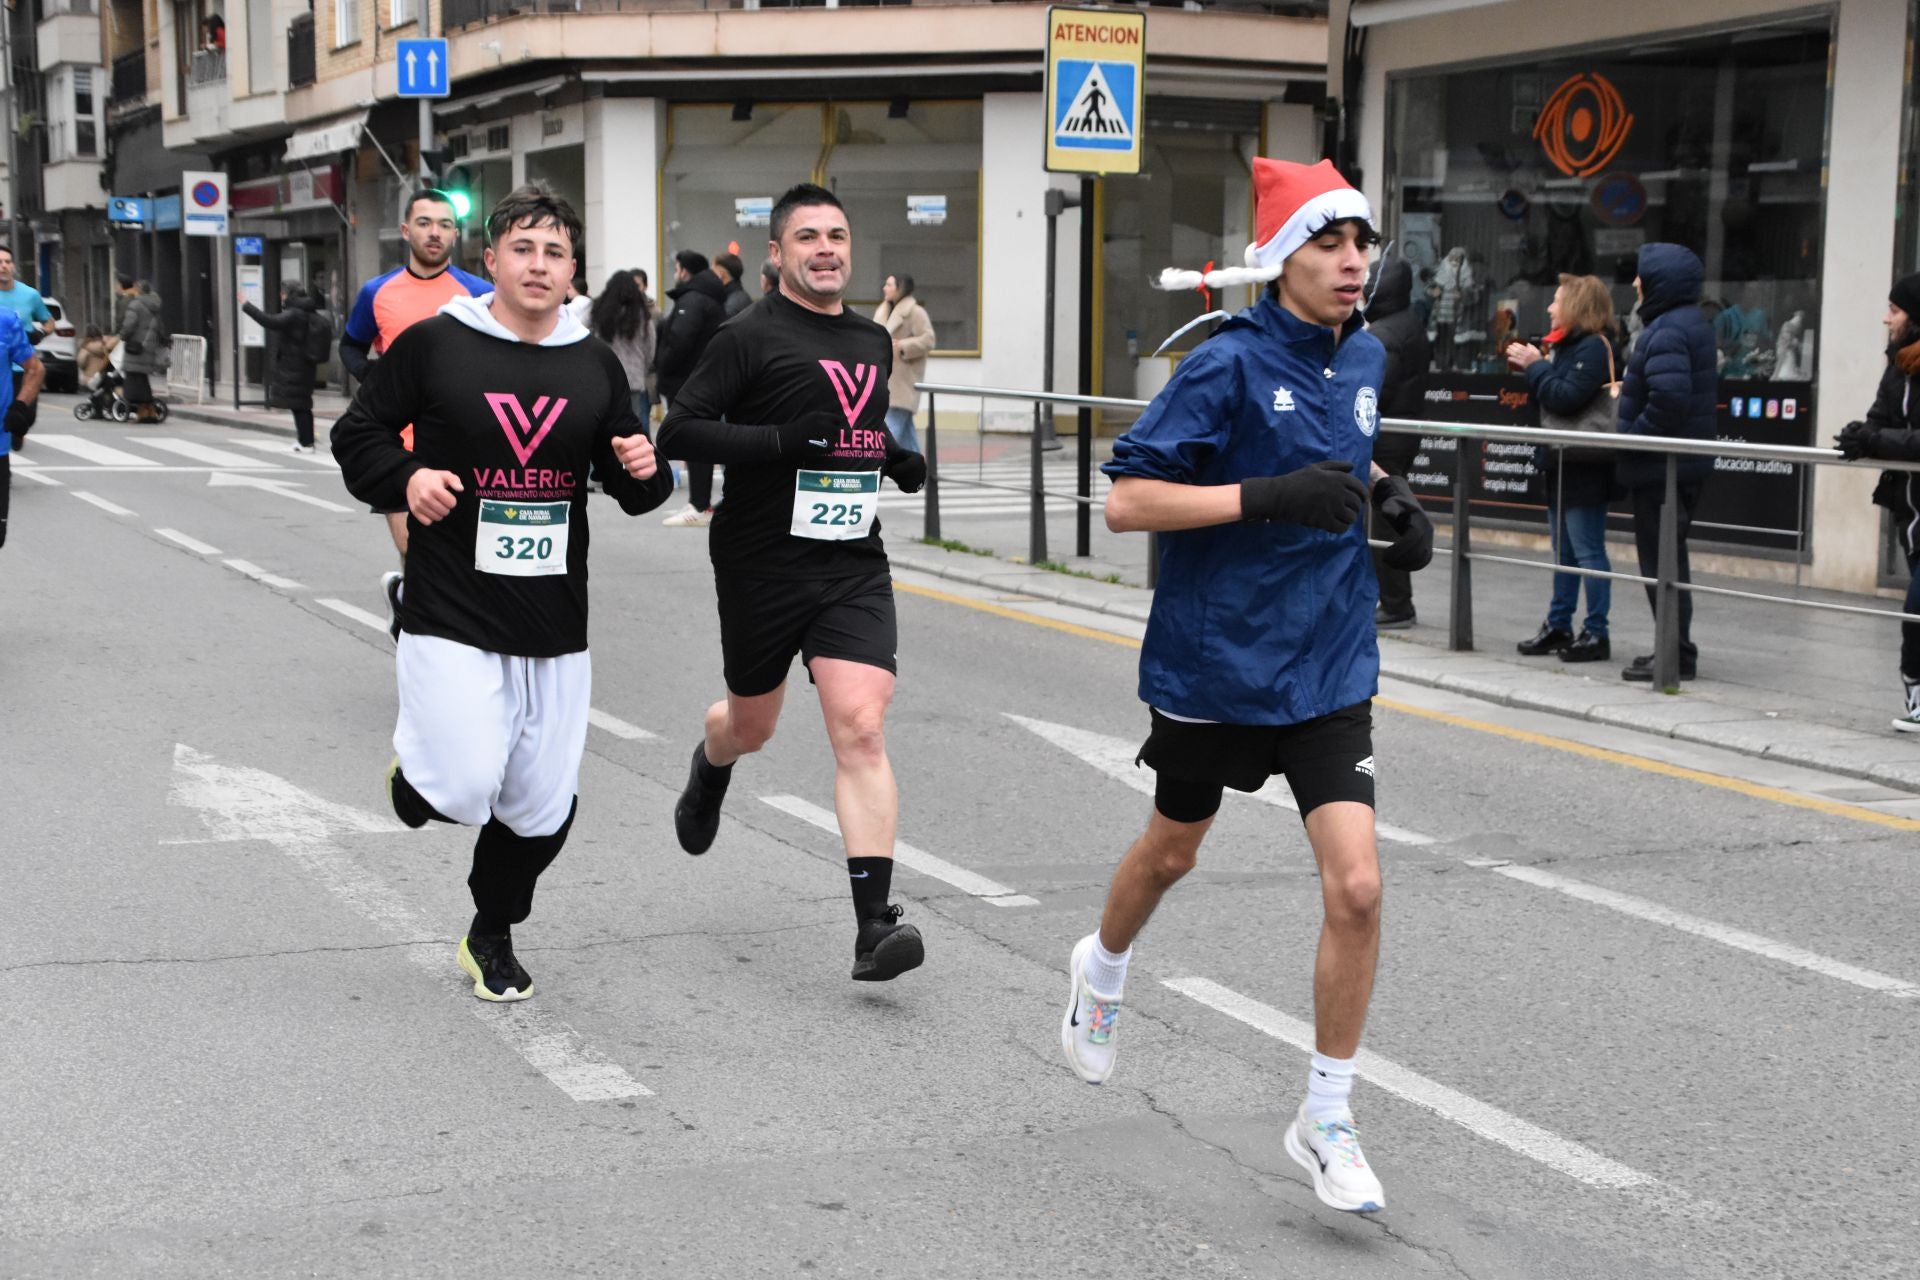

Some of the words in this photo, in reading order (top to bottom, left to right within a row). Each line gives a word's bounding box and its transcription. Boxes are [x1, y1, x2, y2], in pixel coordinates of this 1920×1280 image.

[1055, 23, 1139, 44] ATENCION
[1755, 459, 1793, 475] auditiva
[810, 503, 863, 525] 225
[496, 536, 553, 559] 320
